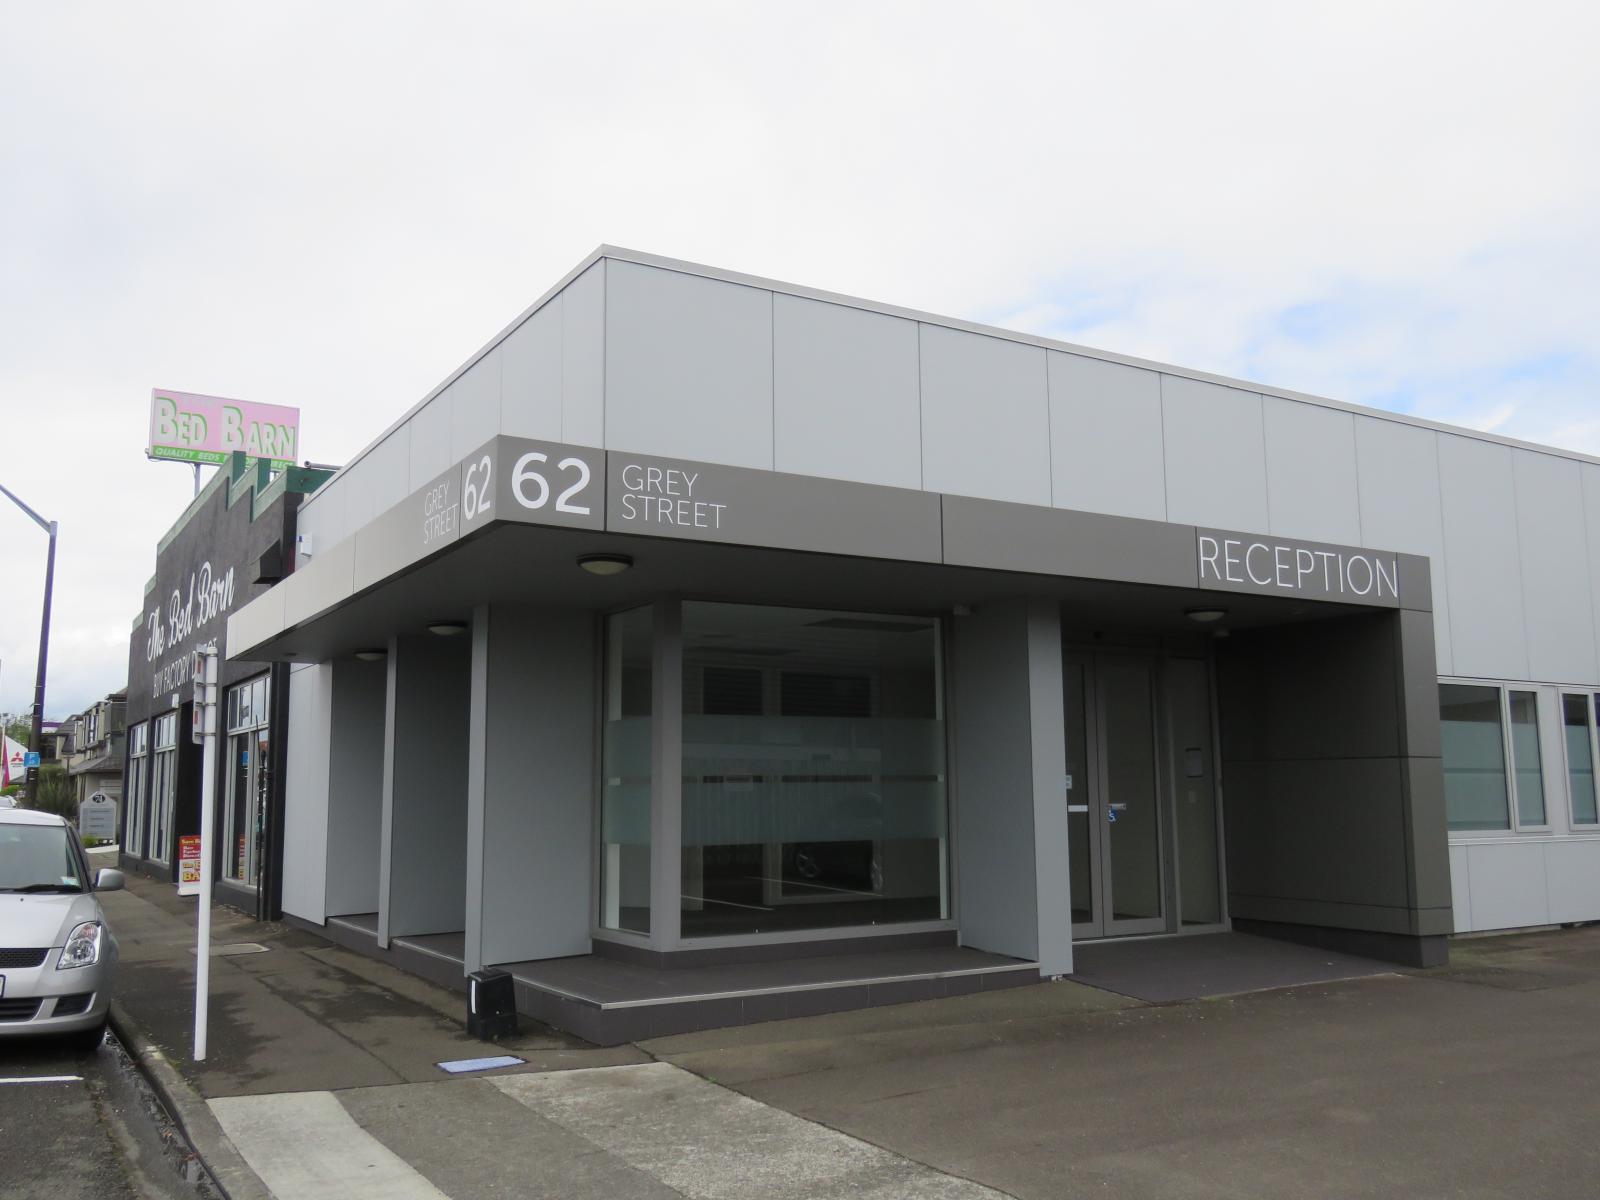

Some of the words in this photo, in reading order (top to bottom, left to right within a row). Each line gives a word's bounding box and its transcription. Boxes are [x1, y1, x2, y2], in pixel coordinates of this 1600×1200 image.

[155, 447, 196, 459] QUALITY
[424, 479, 450, 517] GREY
[463, 455, 492, 521] 62
[511, 452, 591, 516] 62
[622, 464, 699, 497] GREY
[423, 503, 458, 545] STREET
[622, 493, 728, 529] STREET
[1199, 536, 1398, 598] RECEPTION
[147, 605, 165, 662] The
[168, 572, 195, 649] Bed
[197, 560, 235, 629] Barn
[163, 652, 191, 695] FACTORY
